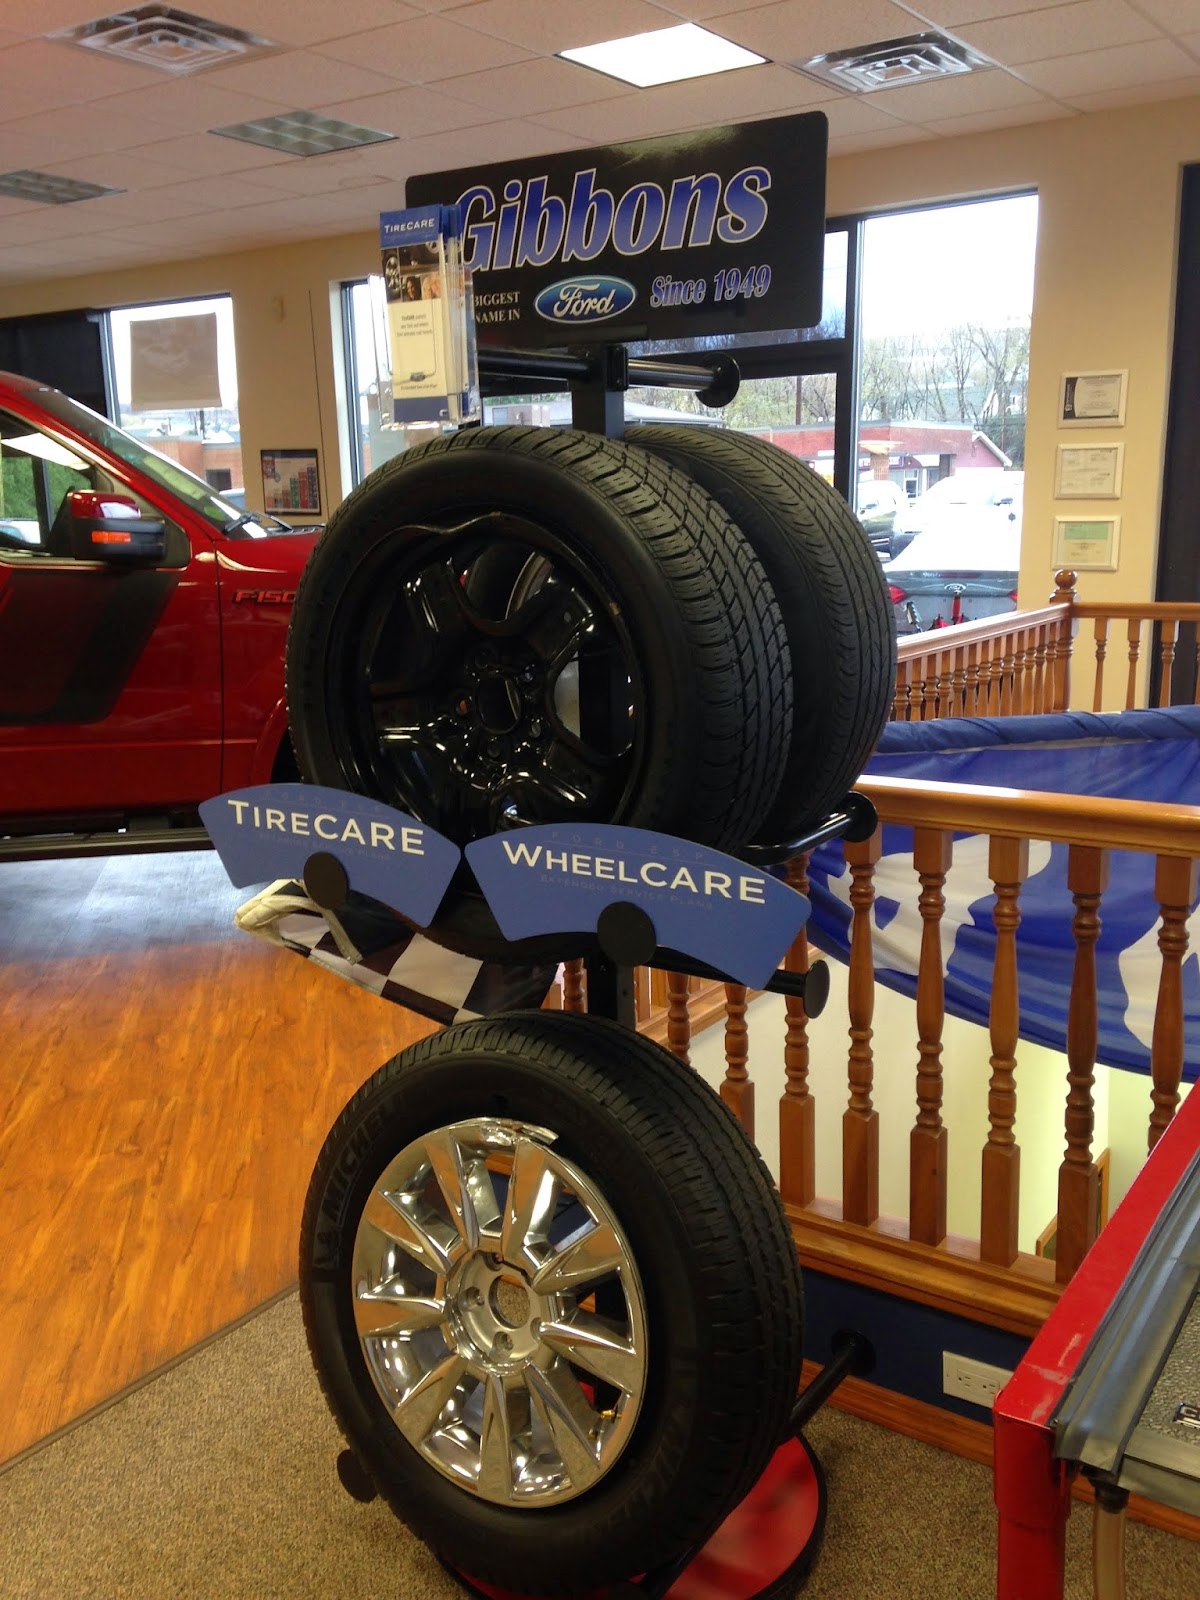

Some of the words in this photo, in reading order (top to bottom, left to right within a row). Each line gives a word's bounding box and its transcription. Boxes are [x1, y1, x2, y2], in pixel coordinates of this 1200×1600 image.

[456, 165, 772, 273] Gibbons
[552, 283, 617, 316] Ford
[650, 275, 706, 308] Since
[713, 264, 772, 299] 1949
[475, 309, 506, 323] NAME
[508, 307, 521, 320] IN
[228, 800, 425, 855] TIRECARE
[502, 841, 766, 904] WHEELCARE
